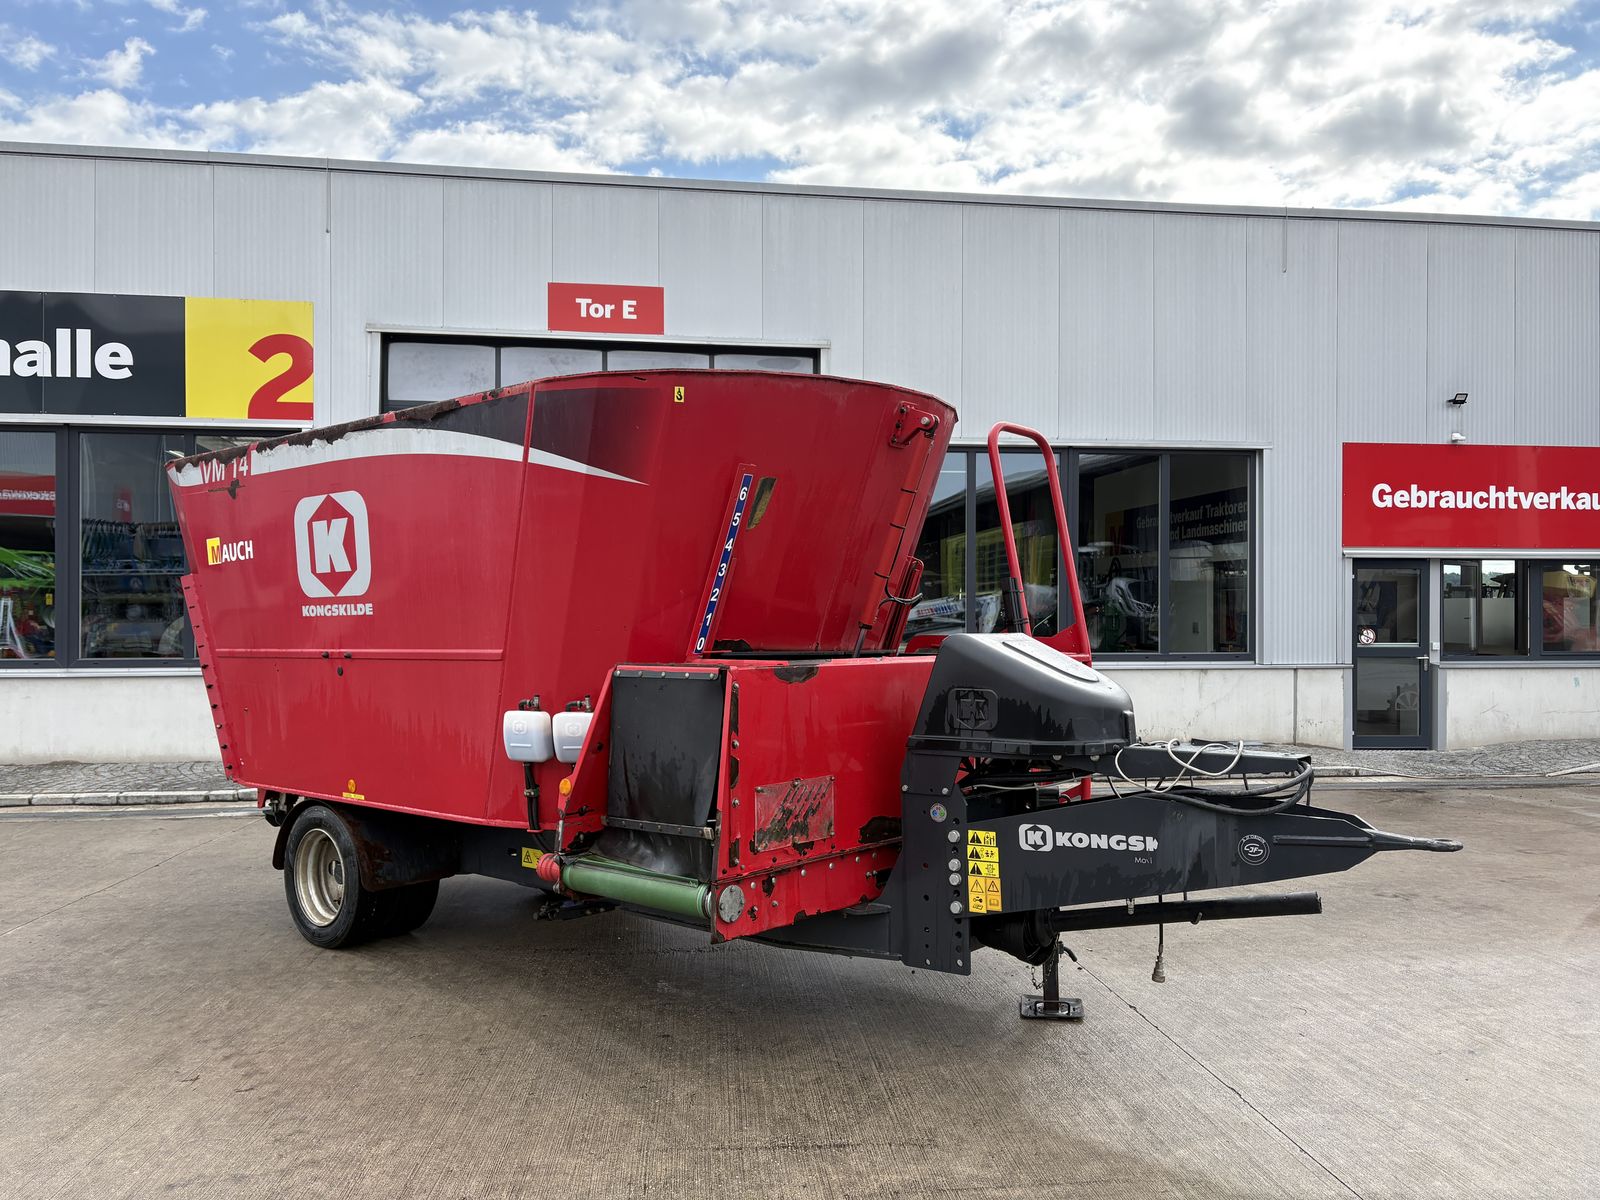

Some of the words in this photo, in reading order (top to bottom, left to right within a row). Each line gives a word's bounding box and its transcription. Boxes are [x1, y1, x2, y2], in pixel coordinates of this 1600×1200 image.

[575, 297, 615, 319] Tor
[622, 299, 638, 320] E
[247, 333, 314, 421] 2
[202, 458, 226, 484] VM
[232, 455, 249, 479] 14
[739, 486, 748, 501] 6
[732, 512, 742, 527] 5
[211, 540, 254, 564] MAUCH
[311, 517, 352, 574] K
[724, 537, 734, 552] 4
[717, 562, 727, 577] 3
[710, 587, 720, 602] 2
[301, 602, 374, 617] KONGSKILDE
[705, 612, 713, 627] 1
[696, 636, 705, 651] 0
